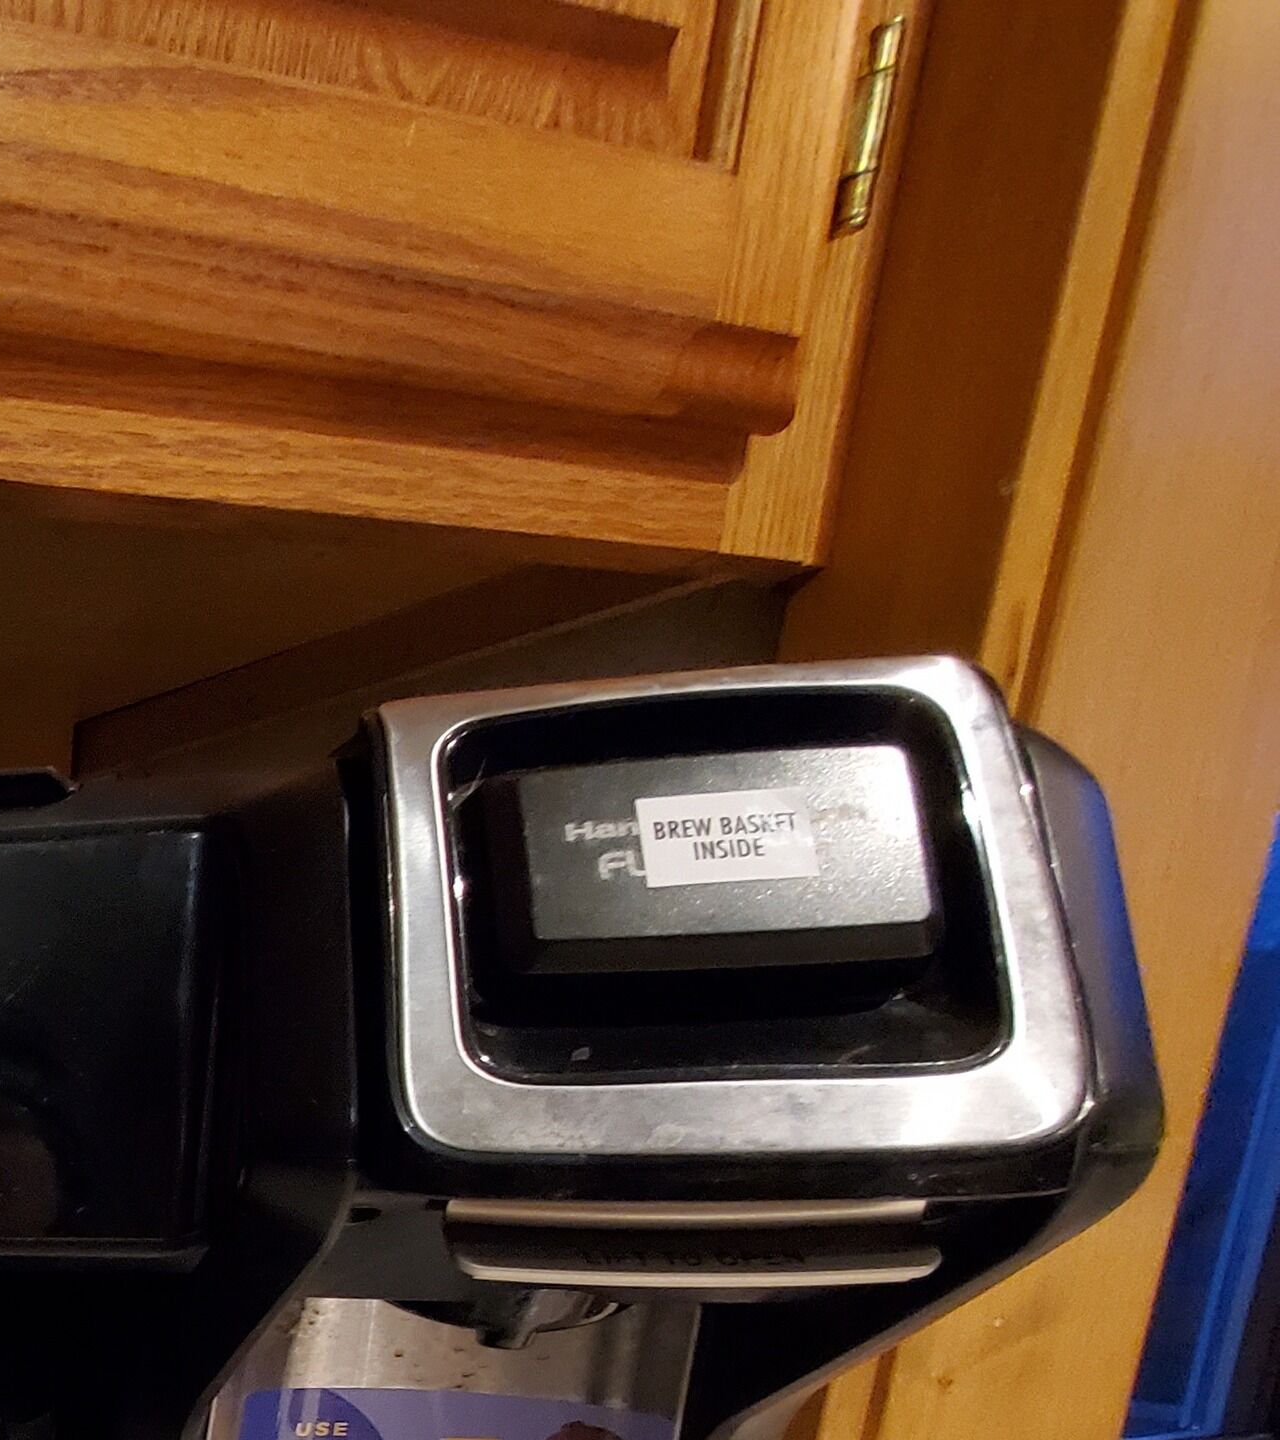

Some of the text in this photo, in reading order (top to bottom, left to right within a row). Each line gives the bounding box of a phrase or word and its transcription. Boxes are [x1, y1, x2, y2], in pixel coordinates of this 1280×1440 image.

[653, 816, 712, 841] BREW
[692, 838, 766, 861] INSIDE
[295, 1421, 348, 1437] USE
